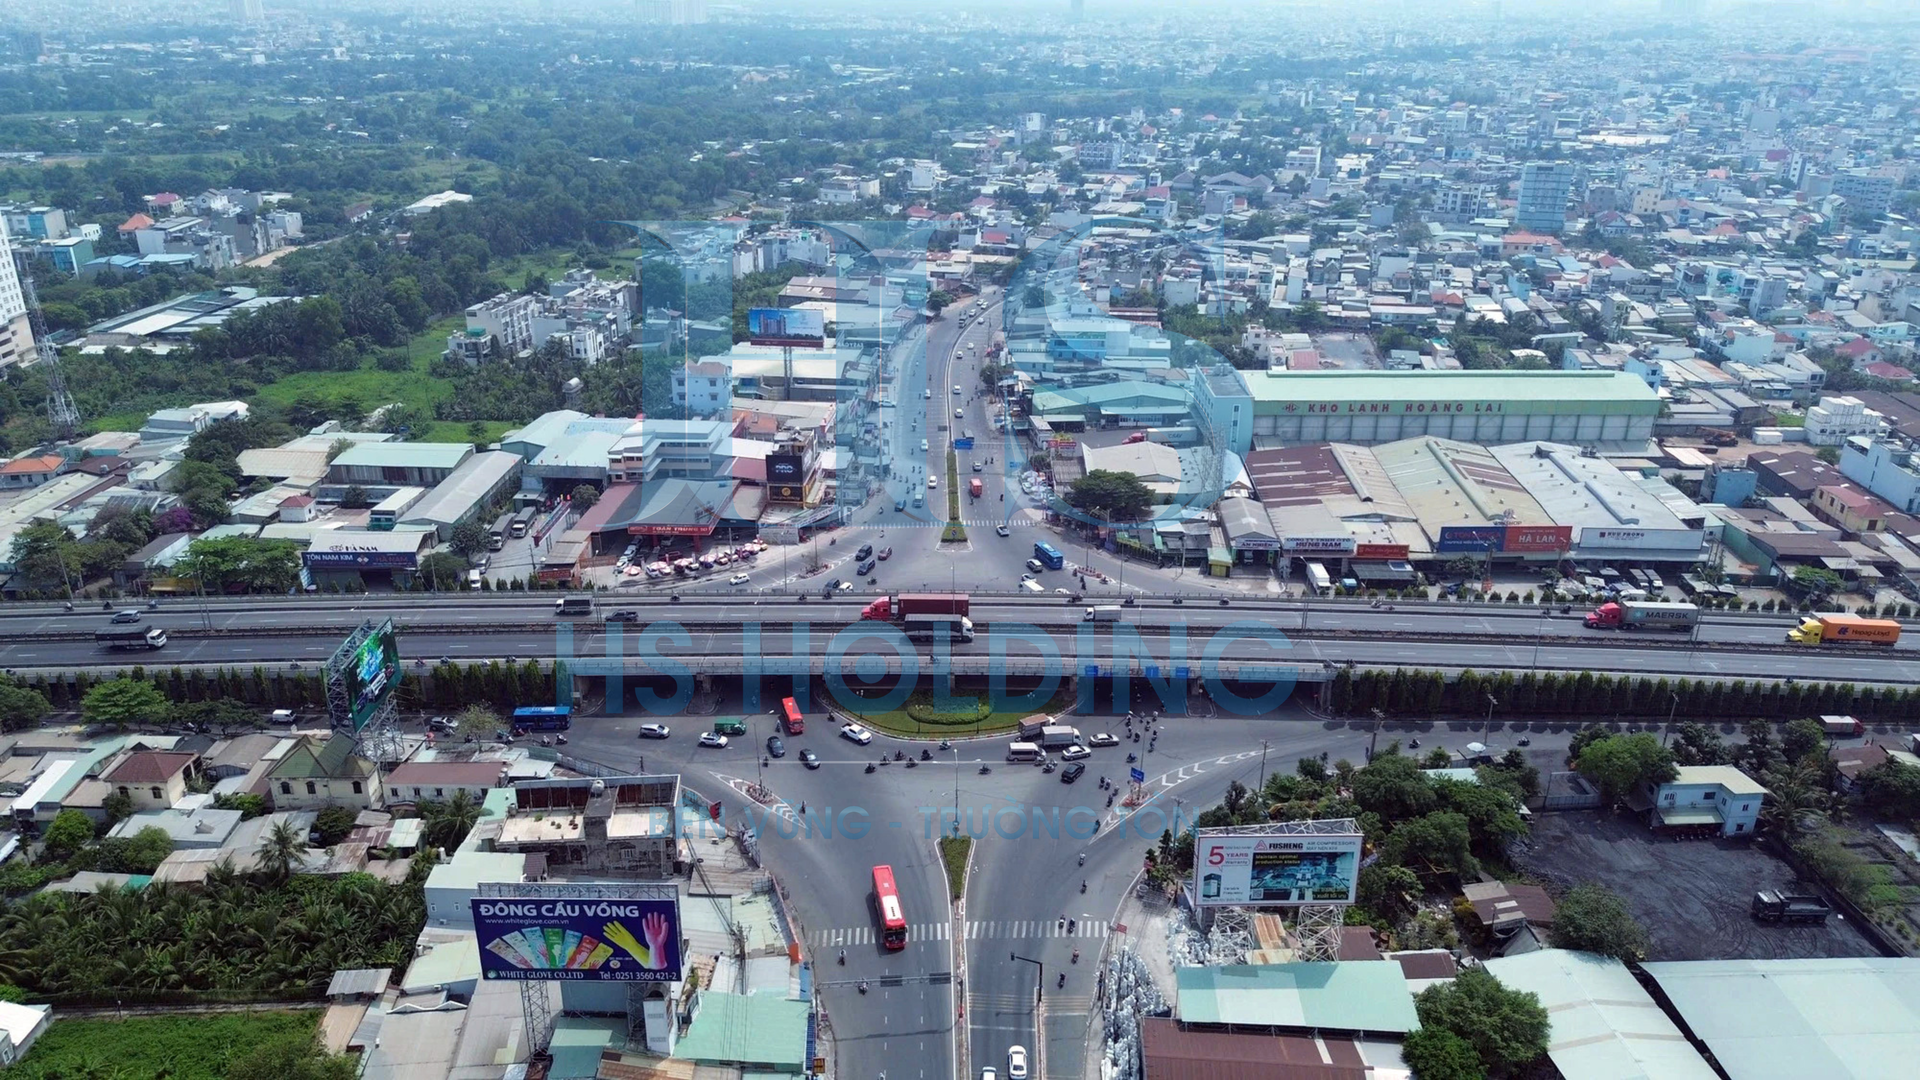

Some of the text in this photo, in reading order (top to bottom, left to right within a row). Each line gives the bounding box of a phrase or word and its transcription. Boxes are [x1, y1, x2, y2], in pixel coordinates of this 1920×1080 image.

[1308, 401, 1503, 415] KHO LẠNH HOÀNG LAI
[1518, 533, 1556, 543] HÀ LAN
[1645, 611, 1689, 620] MAERSK
[1851, 629, 1890, 637] Hapag-Lloyd
[1268, 842, 1304, 850] FUSHENG
[1208, 845, 1225, 866] 5
[479, 902, 538, 916] ĐÔNG
[484, 918, 570, 926] www.whiteglove.com.vn
[499, 970, 526, 979] WHITE
[527, 970, 553, 979] GLOVE
[615, 971, 634, 980] 0251
[635, 971, 654, 980] 3560
[655, 971, 677, 980] 421-2
